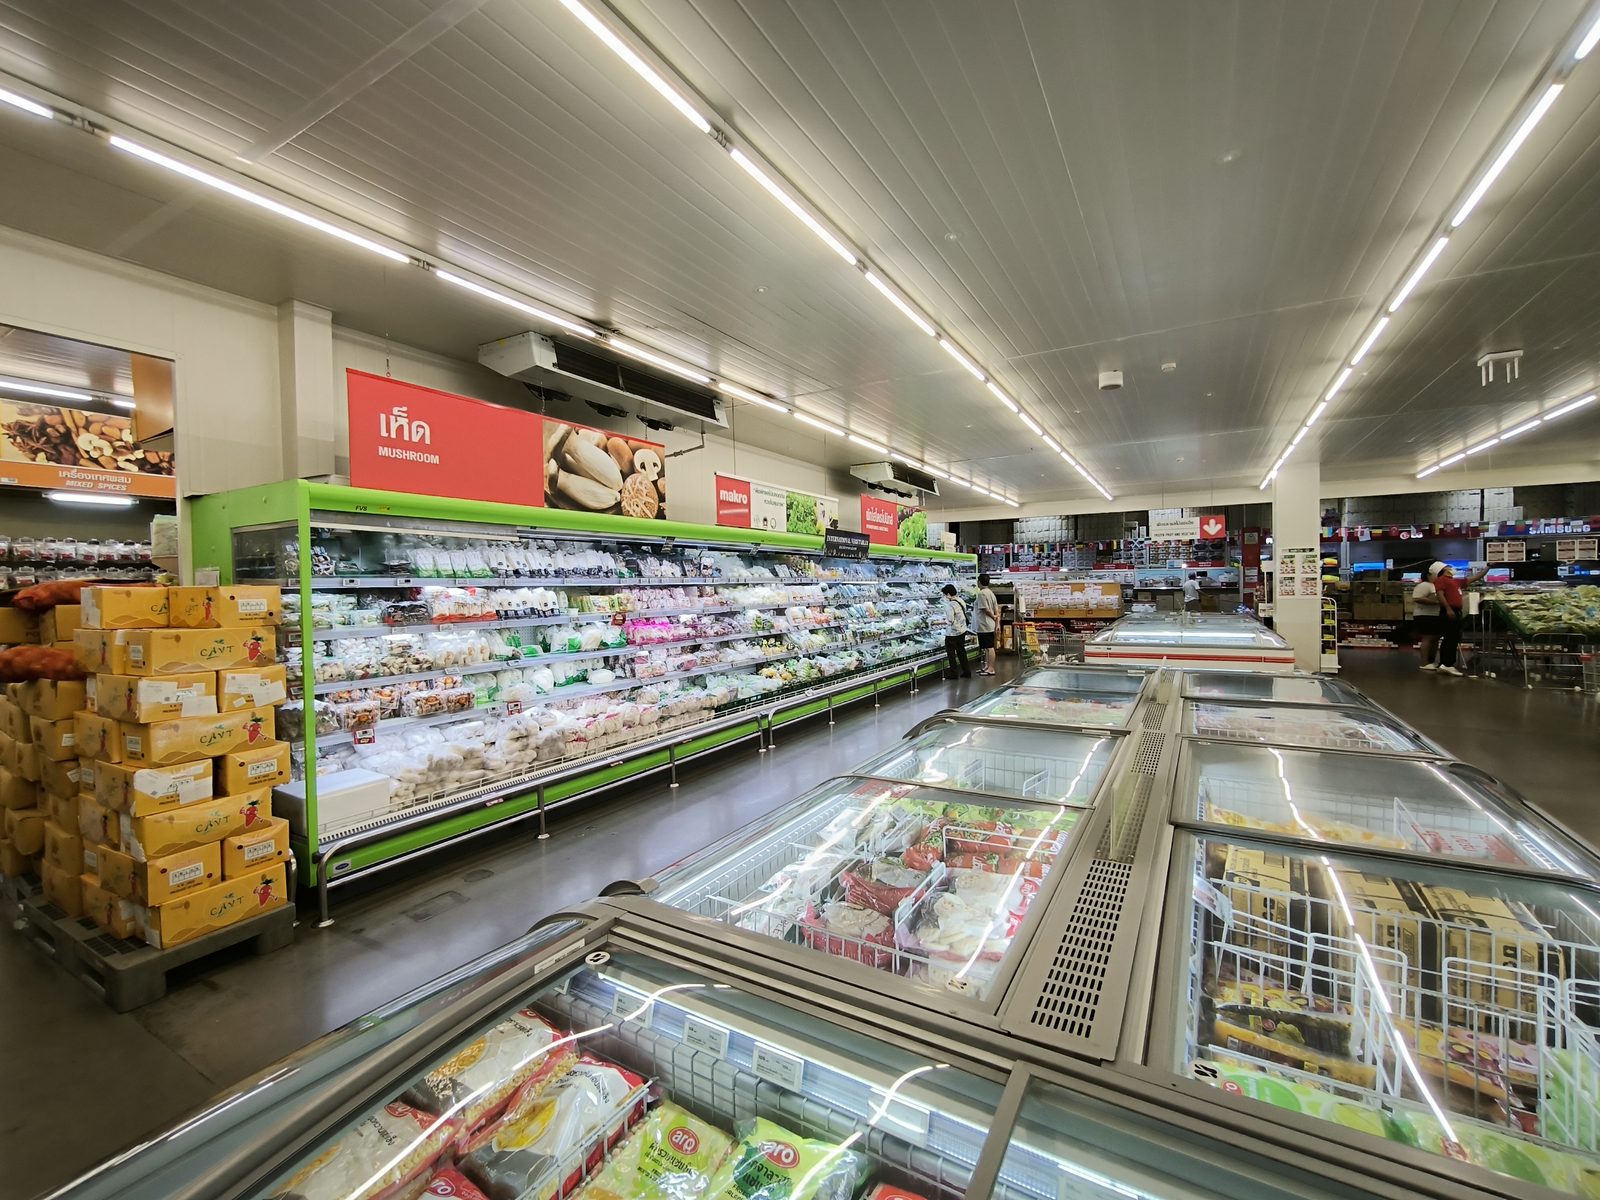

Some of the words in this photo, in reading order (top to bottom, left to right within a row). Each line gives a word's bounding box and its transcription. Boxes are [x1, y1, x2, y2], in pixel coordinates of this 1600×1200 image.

[380, 406, 431, 445] เห็ด
[378, 446, 440, 465] MUSHROOM
[66, 480, 94, 489] MIXED
[97, 482, 128, 491] SPICES
[719, 488, 748, 505] makro
[672, 1130, 697, 1152] aro
[762, 1141, 795, 1164] aro
